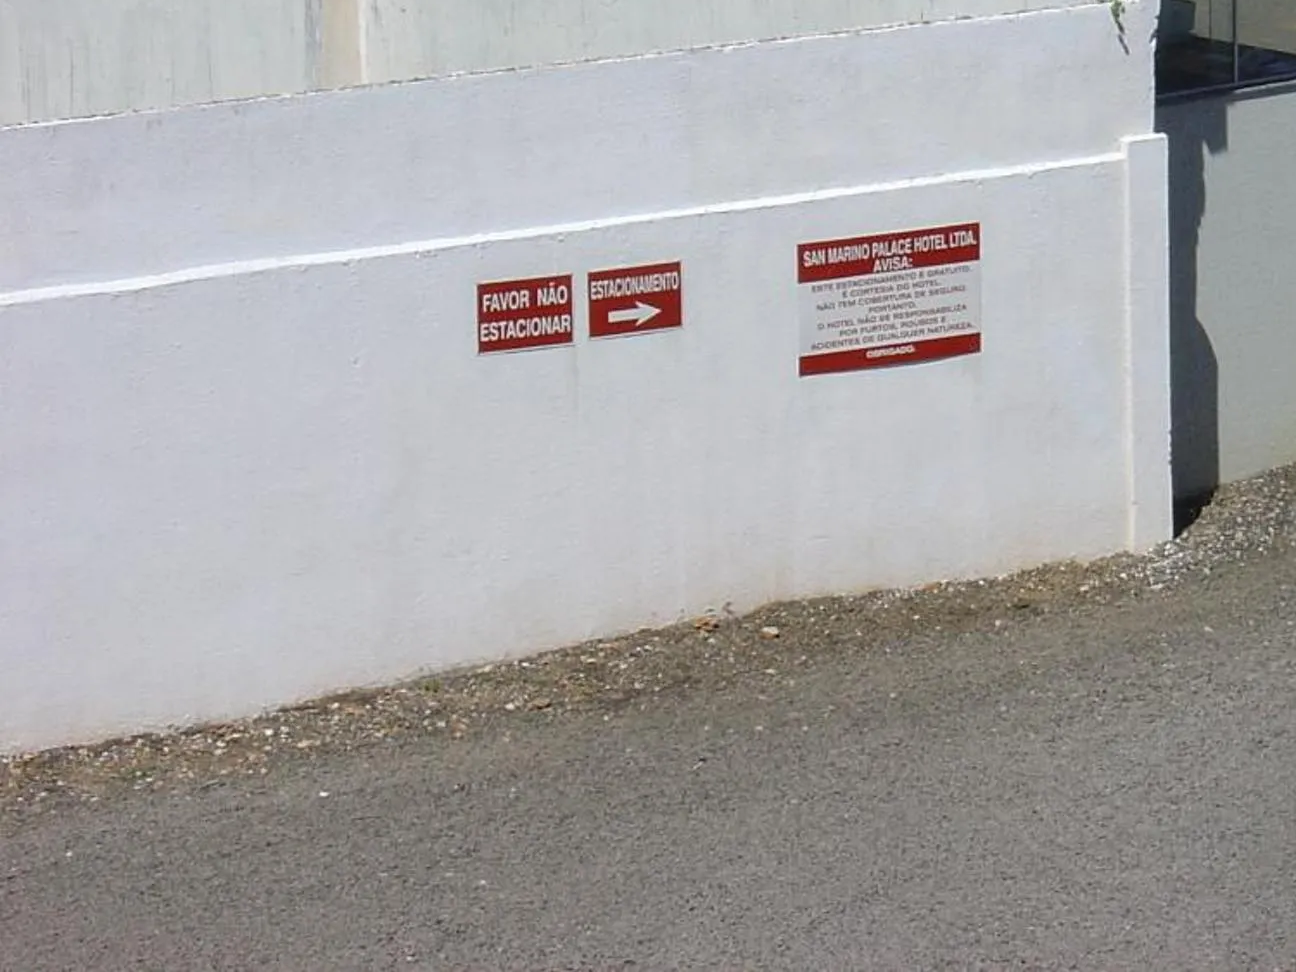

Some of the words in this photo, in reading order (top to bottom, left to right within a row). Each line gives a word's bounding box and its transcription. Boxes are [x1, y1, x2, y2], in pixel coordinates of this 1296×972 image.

[803, 250, 825, 267] SAN
[828, 243, 870, 263] MARINO
[872, 238, 913, 258] PALACE
[914, 234, 948, 253] HOTEL
[949, 230, 978, 248] LTDA.
[873, 256, 914, 273] AVISA:
[591, 271, 679, 300] ESTACIONAMENTO
[811, 282, 834, 293] ESTE
[835, 272, 917, 290] ESTACIONAMENTO
[850, 285, 894, 298] CORTESIA
[896, 284, 910, 293] DO
[483, 290, 530, 312] FAVOR
[537, 281, 568, 307] NÃO
[816, 298, 836, 311] NÃO
[837, 299, 856, 309] TEM
[858, 292, 912, 306] COBERTURA
[914, 290, 926, 300] DE
[480, 315, 571, 342] ESTACIONAR
[817, 323, 825, 331] O
[827, 318, 854, 329] HOTEL
[857, 313, 877, 325] NÃO
[879, 313, 890, 323] SE
[892, 304, 967, 321] RESPONSABILIZA
[811, 338, 861, 351] ACIDENTES
[862, 335, 875, 344] DE
[877, 329, 925, 342] QUALQUER
[839, 328, 858, 338] POR
